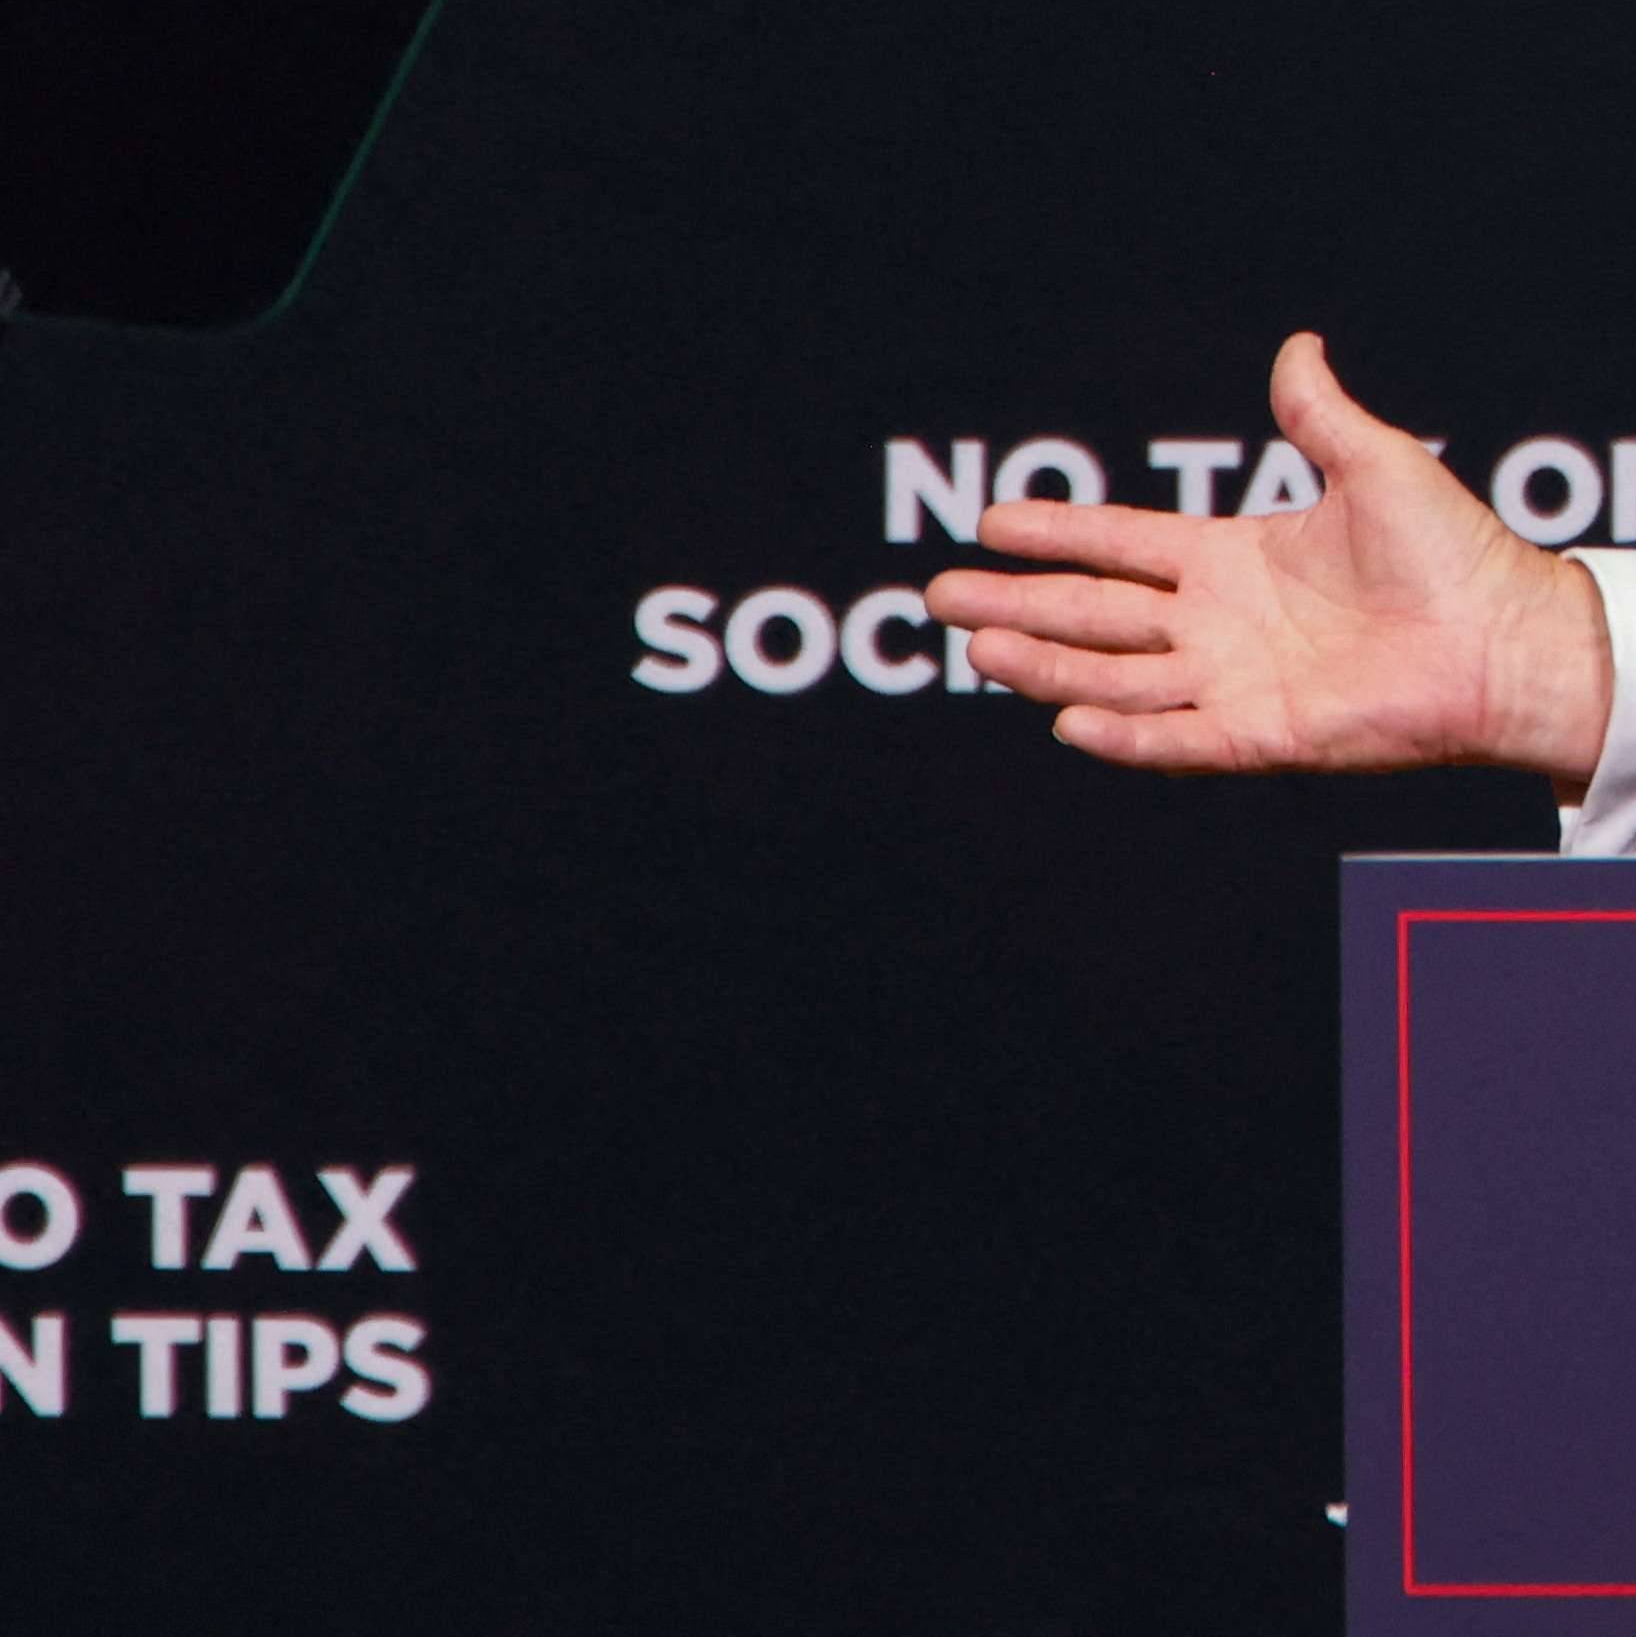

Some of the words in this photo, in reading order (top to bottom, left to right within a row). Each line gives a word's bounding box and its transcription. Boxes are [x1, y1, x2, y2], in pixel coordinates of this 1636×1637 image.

[883, 437, 1107, 545] NO
[1146, 438, 1449, 520] TA
[121, 1163, 417, 1273] TAX
[109, 1312, 430, 1422] TIPS
